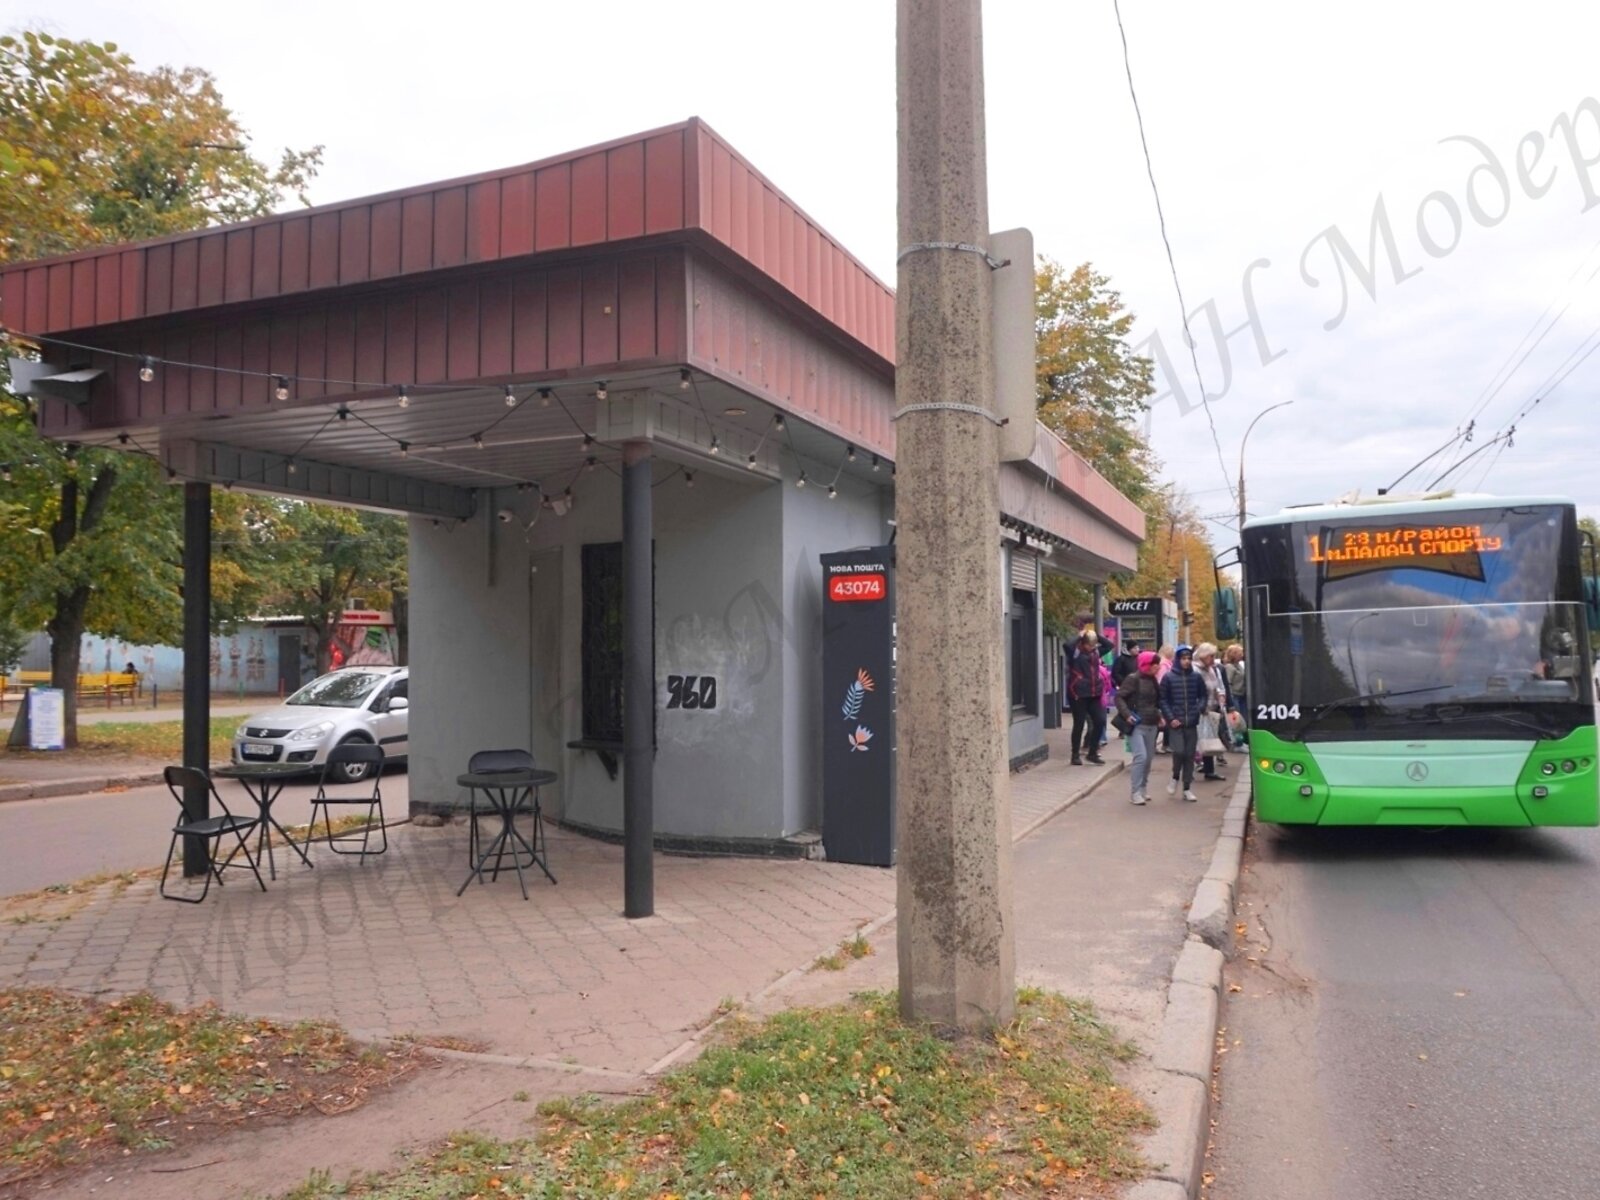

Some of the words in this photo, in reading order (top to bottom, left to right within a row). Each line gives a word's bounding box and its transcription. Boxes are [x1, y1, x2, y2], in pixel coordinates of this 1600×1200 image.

[1419, 537, 1502, 554] СПОРТУ
[854, 564, 885, 572] ПОШТА
[834, 580, 880, 595] 43074
[1257, 703, 1301, 720] 2104
